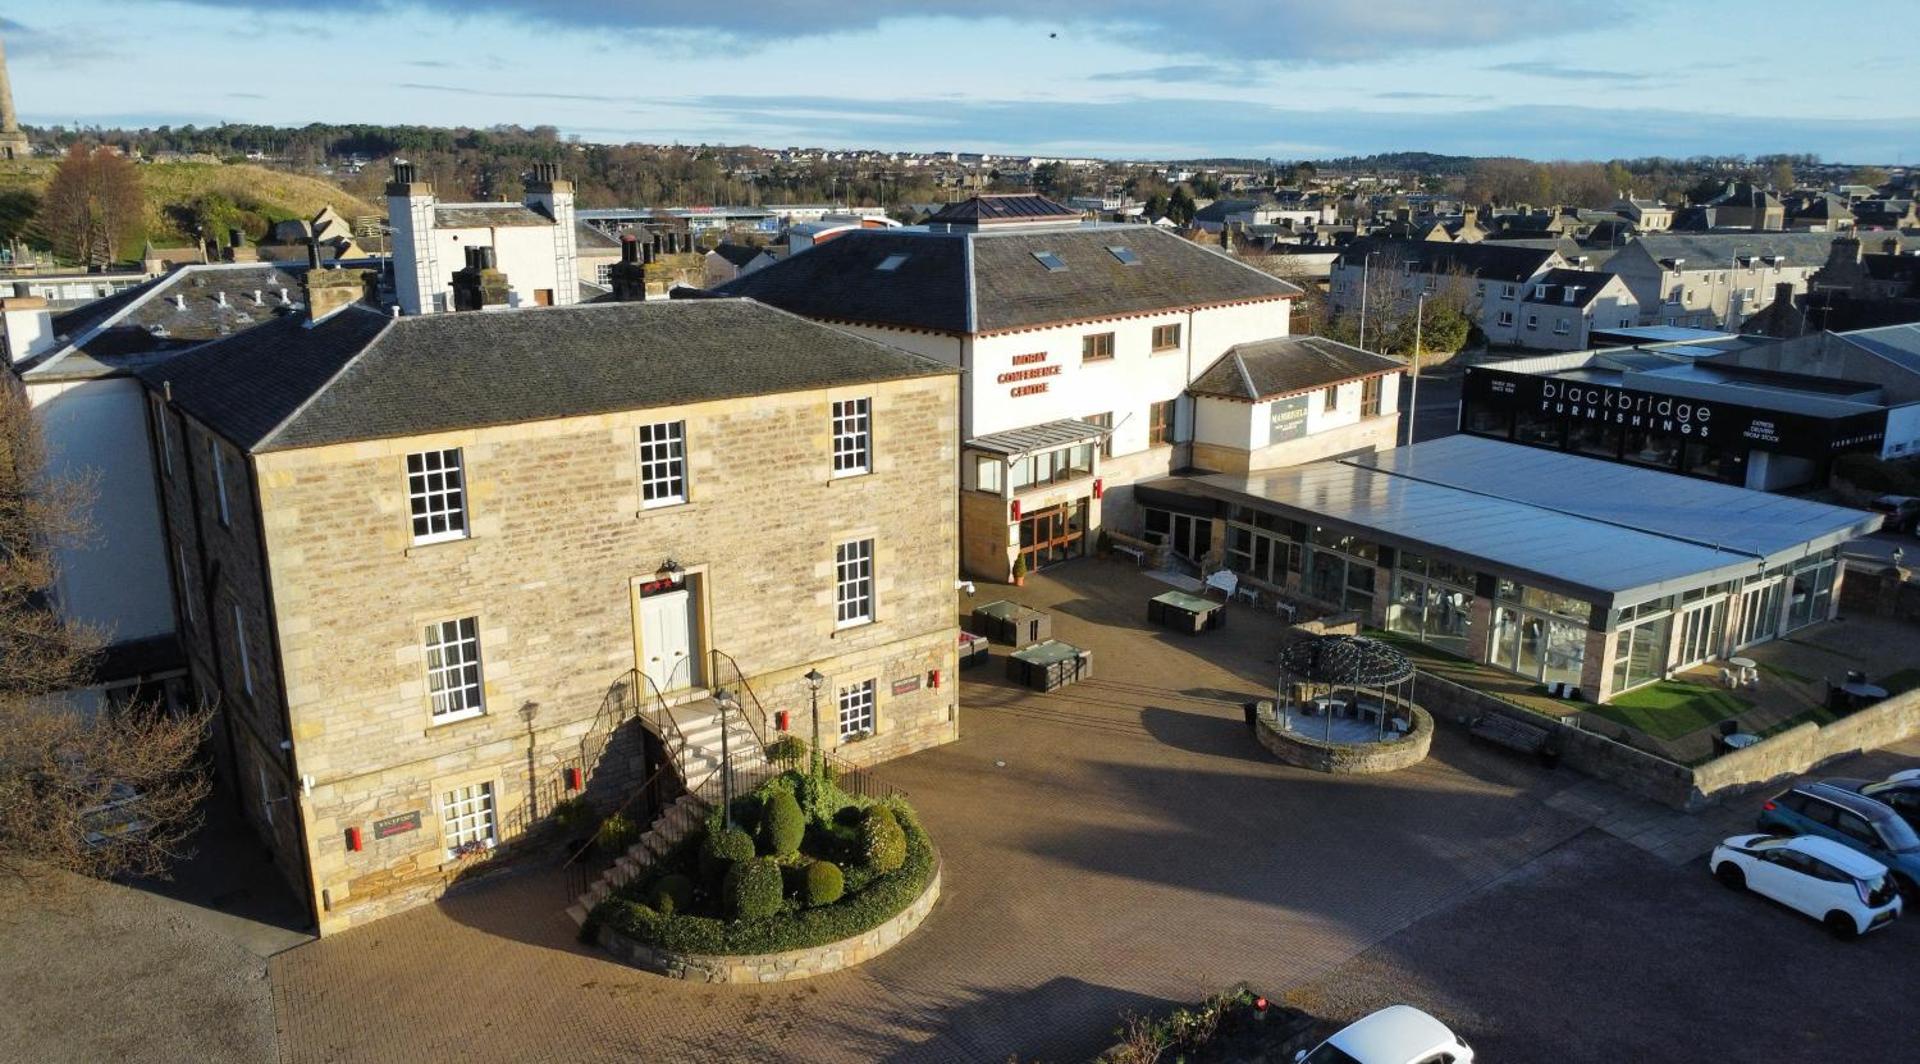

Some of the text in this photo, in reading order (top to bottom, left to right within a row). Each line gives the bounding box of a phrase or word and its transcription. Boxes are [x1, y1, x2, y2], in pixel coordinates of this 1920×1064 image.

[1012, 351, 1047, 366] MORAY
[997, 365, 1062, 384] CONFERENCE
[1011, 383, 1049, 398] CENTRE
[1543, 380, 1711, 423] blackbridge
[1542, 401, 1709, 438] FURNISHINGS
